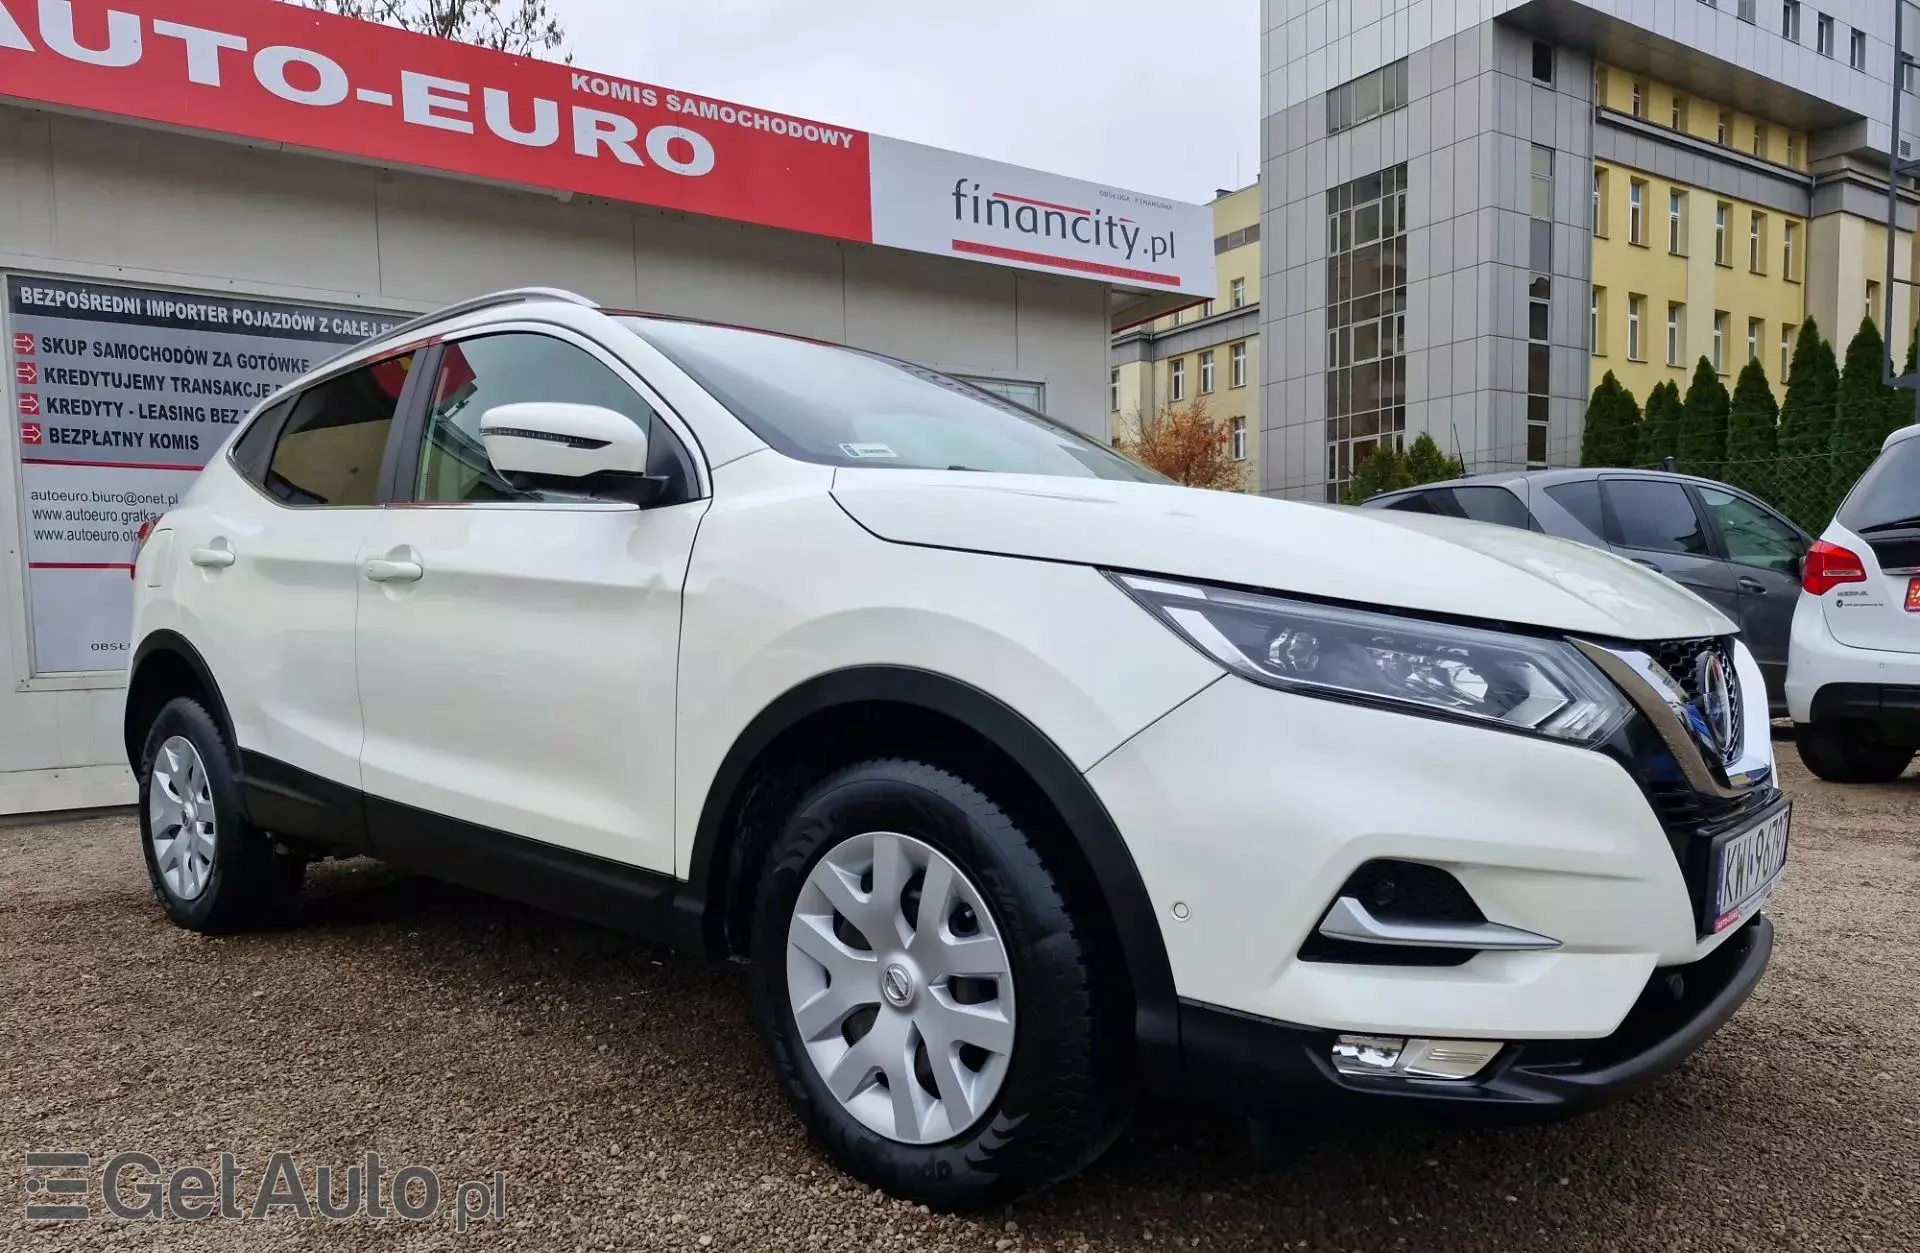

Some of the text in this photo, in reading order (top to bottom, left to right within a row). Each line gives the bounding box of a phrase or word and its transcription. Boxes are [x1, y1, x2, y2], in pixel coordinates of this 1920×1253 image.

[571, 72, 854, 149] KOMIS SAMOCHODOWY
[951, 177, 1176, 262] financity.pl
[20, 286, 141, 315] BEZPOŚREDNI
[147, 299, 229, 323] IMPORTER
[232, 308, 315, 332] POJAZDÓW
[319, 317, 329, 333] Z
[332, 318, 377, 337] CAŁEJ
[41, 336, 88, 356] SKUP
[92, 341, 209, 366] SAMOCHODÓW
[212, 351, 233, 368] ZA
[44, 367, 166, 392] KREDYTUJEMY
[170, 377, 271, 399] TRANSAKCJE
[46, 397, 124, 418] KREDYTY
[138, 403, 206, 423] LEASING
[210, 408, 240, 425] BEZ
[49, 427, 200, 451] BEZPŁATNY KOMIS
[30, 489, 179, 507] autoeuro.biuro@onet.pl
[32, 507, 164, 525] www.autoeuro.gratka
